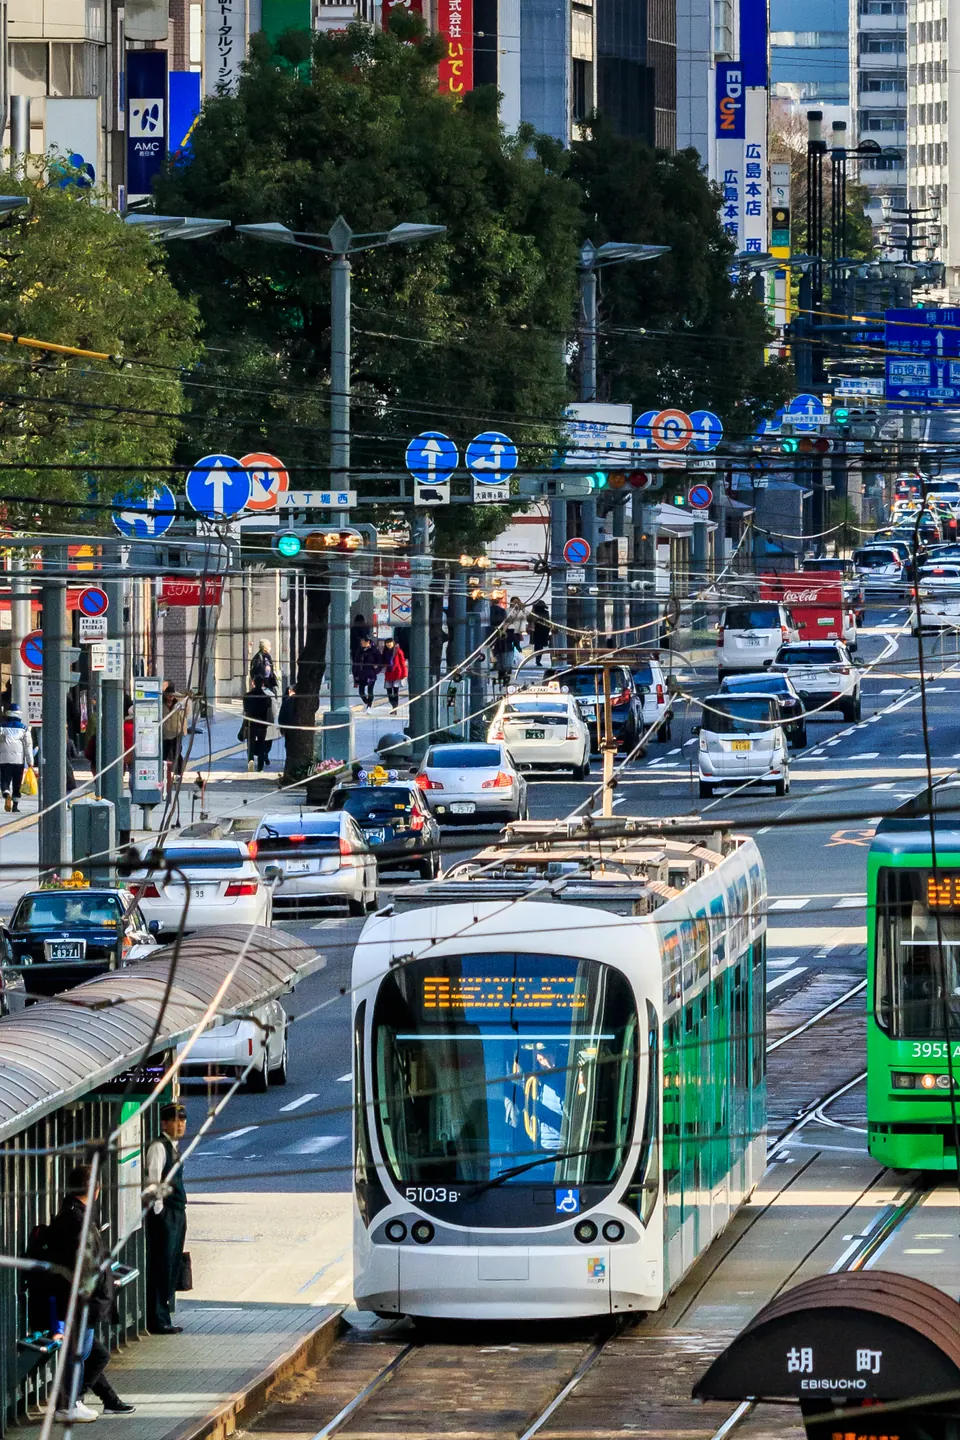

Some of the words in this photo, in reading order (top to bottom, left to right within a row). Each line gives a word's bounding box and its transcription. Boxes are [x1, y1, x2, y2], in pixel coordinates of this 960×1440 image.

[720, 70, 742, 130] EDION
[746, 144, 761, 216] 広島本店
[724, 170, 738, 236] 広島本店
[926, 312, 954, 322] 横川
[893, 365, 927, 375] 市役所
[285, 493, 348, 504] 八丁堀西
[475, 491, 508, 499] 大貨等を除く
[783, 587, 820, 601] Coca-Cola
[57, 949, 78, 957] 89-71
[787, 1347, 882, 1374] 胡町
[801, 1379, 866, 1389] EBISUCHO
